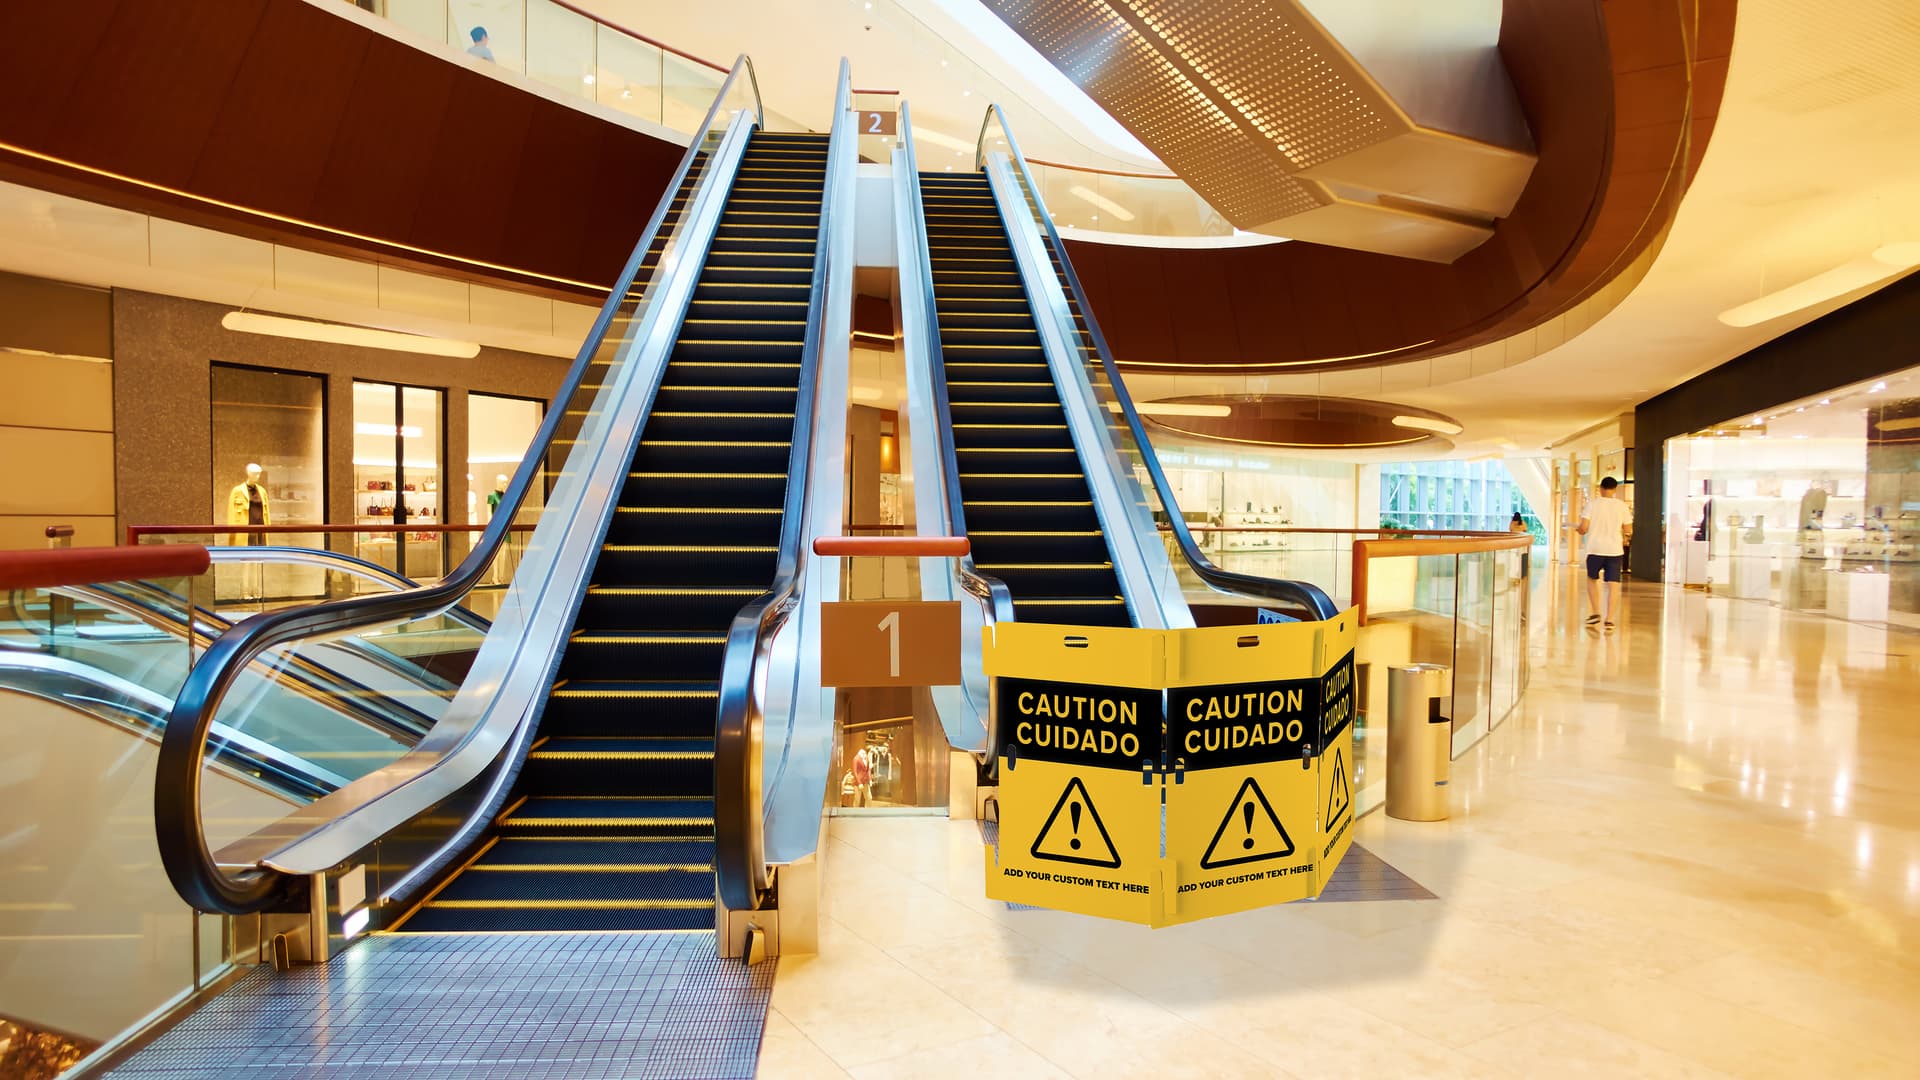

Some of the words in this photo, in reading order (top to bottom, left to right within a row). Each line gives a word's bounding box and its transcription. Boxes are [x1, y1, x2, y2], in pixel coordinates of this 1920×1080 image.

[868, 113, 882, 133] 2
[877, 611, 900, 678] 1
[1325, 662, 1350, 703] CAUTION
[1018, 691, 1137, 725] CAUTION
[1186, 689, 1303, 722] CAUTION
[1016, 722, 1139, 757] CUIDADO
[1185, 719, 1303, 753] CUIDADO
[1004, 868, 1024, 877] ADD
[1025, 870, 1051, 881] YOUR
[1053, 874, 1094, 887] CUSTOM
[1096, 879, 1121, 890] TEXT
[1122, 883, 1150, 894] HERE
[1177, 883, 1198, 893] ADD
[1199, 879, 1225, 890] YOUR
[1226, 872, 1264, 885] CUSTOM
[1265, 868, 1289, 879] TEXT
[1289, 864, 1314, 875] HERE
